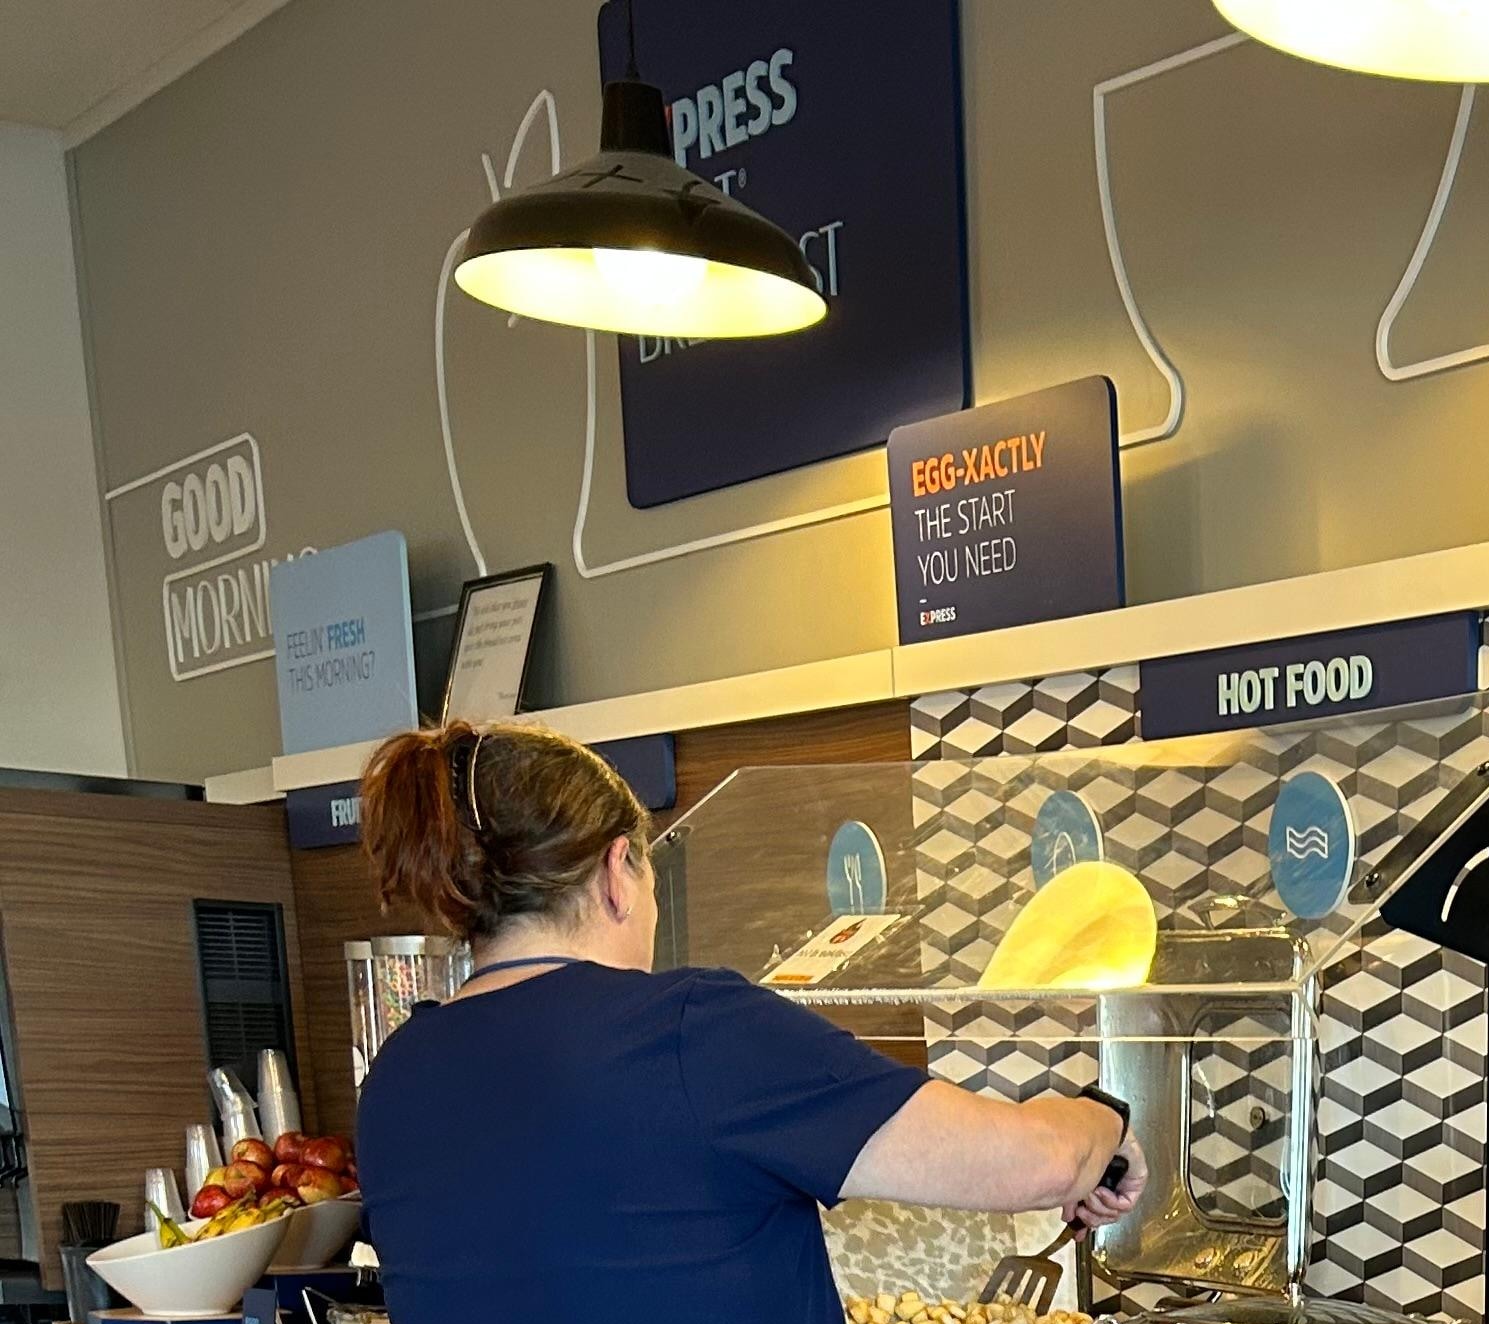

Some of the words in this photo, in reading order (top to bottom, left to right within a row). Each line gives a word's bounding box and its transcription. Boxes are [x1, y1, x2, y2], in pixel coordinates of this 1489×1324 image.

[664, 48, 797, 168] PRESS
[911, 431, 1046, 498] EGG-XACTLY
[161, 455, 255, 559] GOOD
[915, 503, 952, 542] THE
[957, 489, 1016, 535] START
[917, 548, 959, 587] YOU
[965, 537, 1017, 578] NEED
[170, 547, 318, 663] MORNI
[327, 616, 366, 650] FRESH
[920, 607, 957, 627] EXPRESS
[288, 664, 315, 697] THIS
[316, 651, 375, 688] MORNING?
[1218, 667, 1279, 716] HOT
[1286, 655, 1373, 707] FOOD
